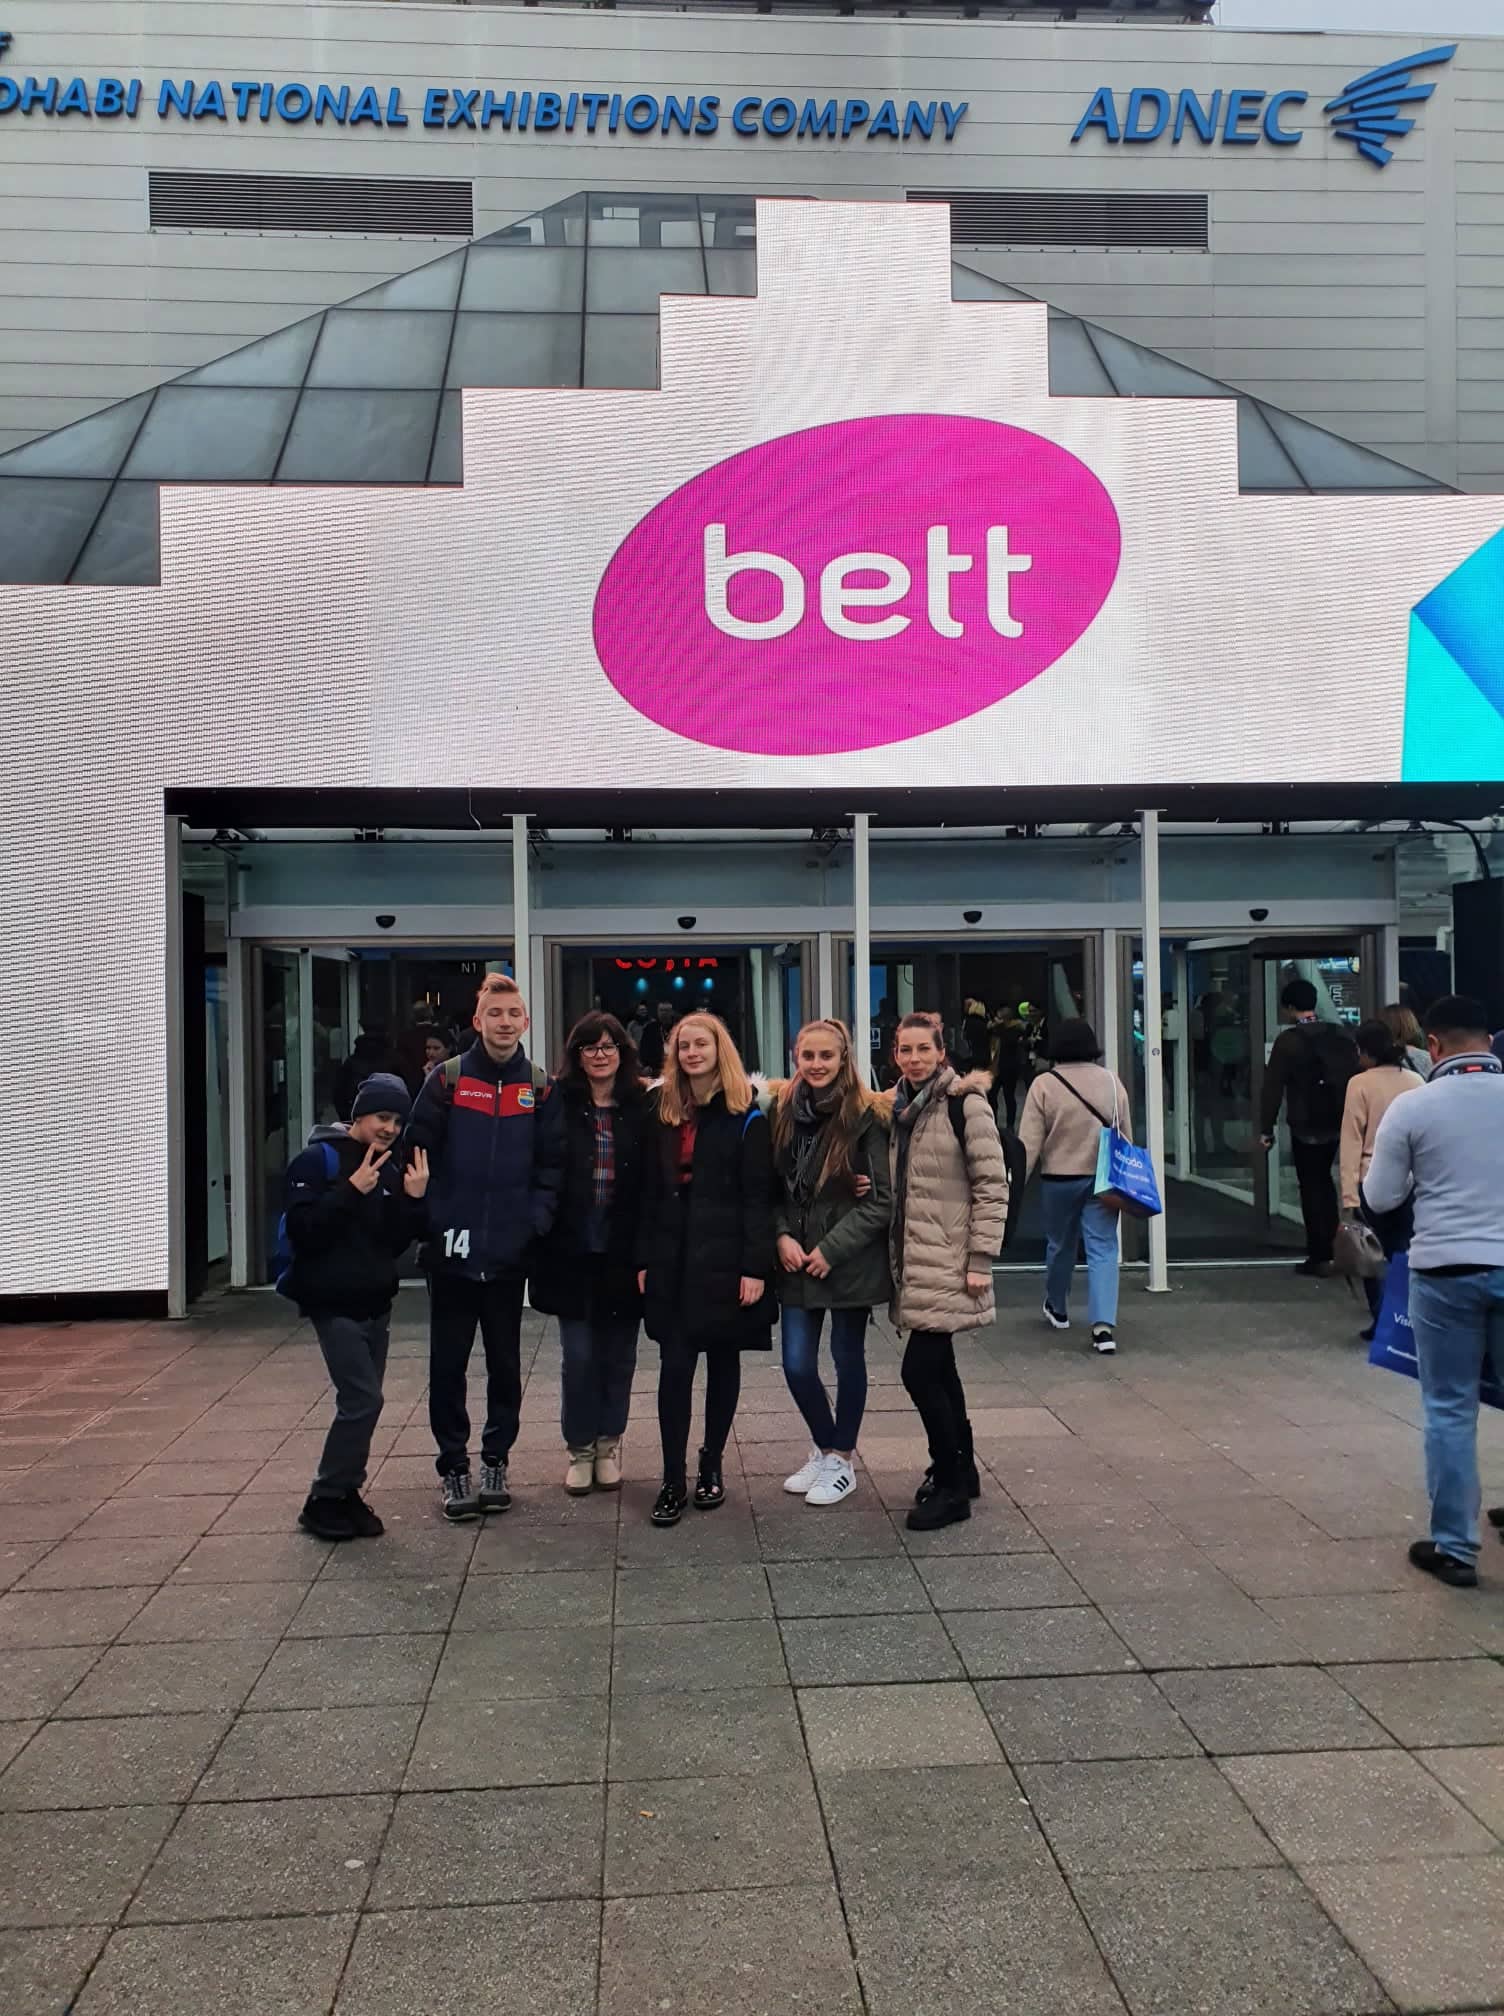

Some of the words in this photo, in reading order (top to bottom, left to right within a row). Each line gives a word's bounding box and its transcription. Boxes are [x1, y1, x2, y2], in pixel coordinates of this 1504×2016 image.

[157, 79, 410, 125] NATIONAL
[422, 88, 722, 134] EXHIBITIONS
[732, 97, 969, 141] COMPANY
[1072, 87, 1309, 145] ADNEC
[703, 522, 1033, 641] bett
[460, 961, 477, 974] N1
[443, 1228, 470, 1259] 14
